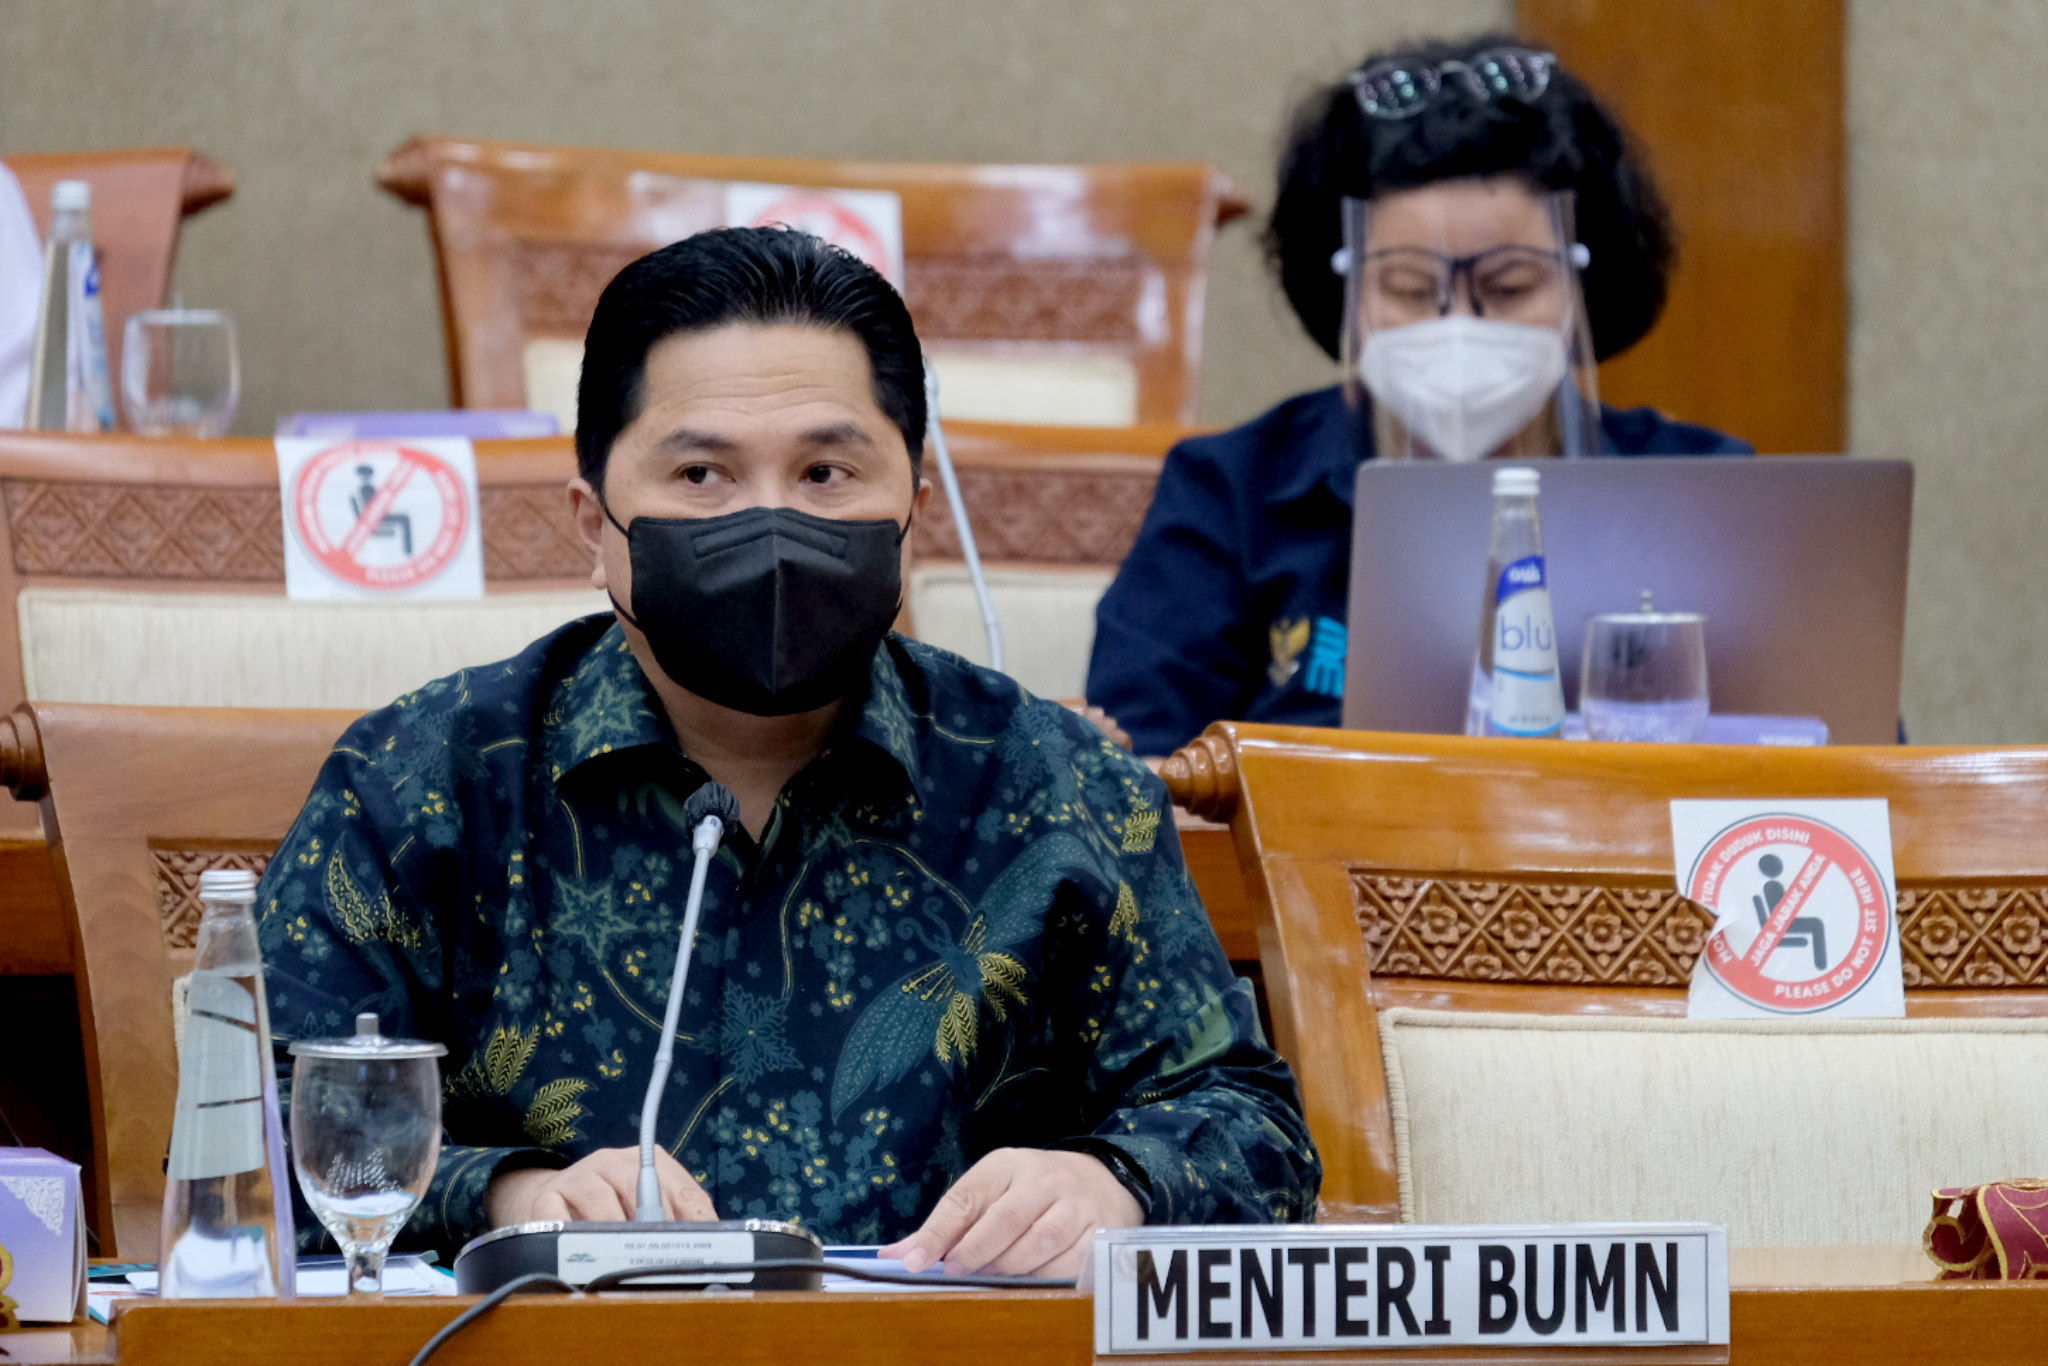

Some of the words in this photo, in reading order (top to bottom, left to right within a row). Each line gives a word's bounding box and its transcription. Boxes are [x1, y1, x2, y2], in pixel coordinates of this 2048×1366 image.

[1702, 862, 1725, 904] TIDAK
[1720, 831, 1763, 861] DUDUK
[1767, 829, 1810, 844] DISINI
[1849, 868, 1875, 904] HERE
[1751, 932, 1777, 966] JAGA
[1773, 888, 1804, 931] JARAK
[1799, 854, 1826, 889] ANDA
[1864, 909, 1877, 933] SIT
[1851, 937, 1874, 969] NOT
[1774, 982, 1831, 999] PLEASE
[1831, 968, 1853, 988] DO
[1136, 1246, 1452, 1340] MENTERI
[1478, 1242, 1680, 1336] BUMN
